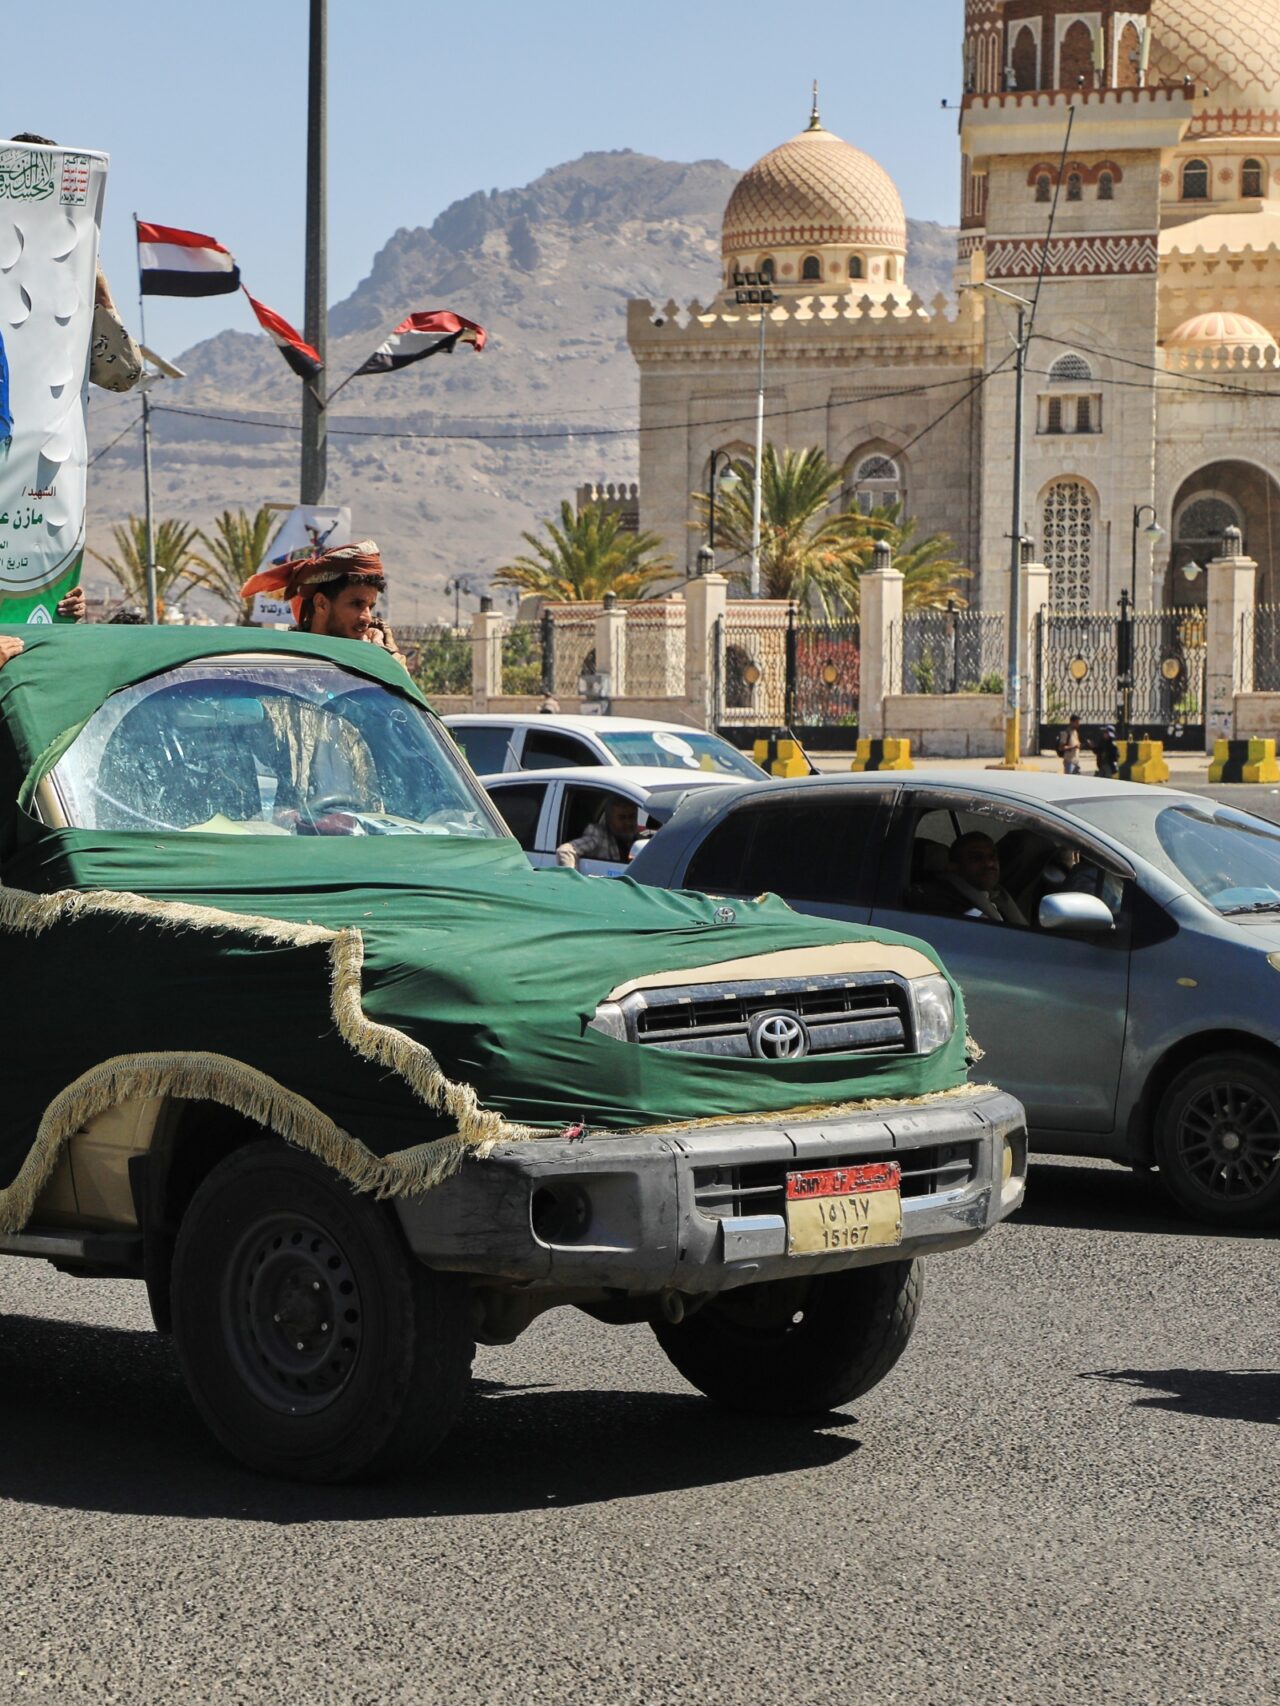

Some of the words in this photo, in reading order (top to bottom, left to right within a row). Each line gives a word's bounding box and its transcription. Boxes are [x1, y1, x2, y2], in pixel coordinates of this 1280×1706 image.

[13, 508, 44, 529] مازن
[7, 556, 29, 570] تاريخ
[822, 1225, 869, 1248] 15167
